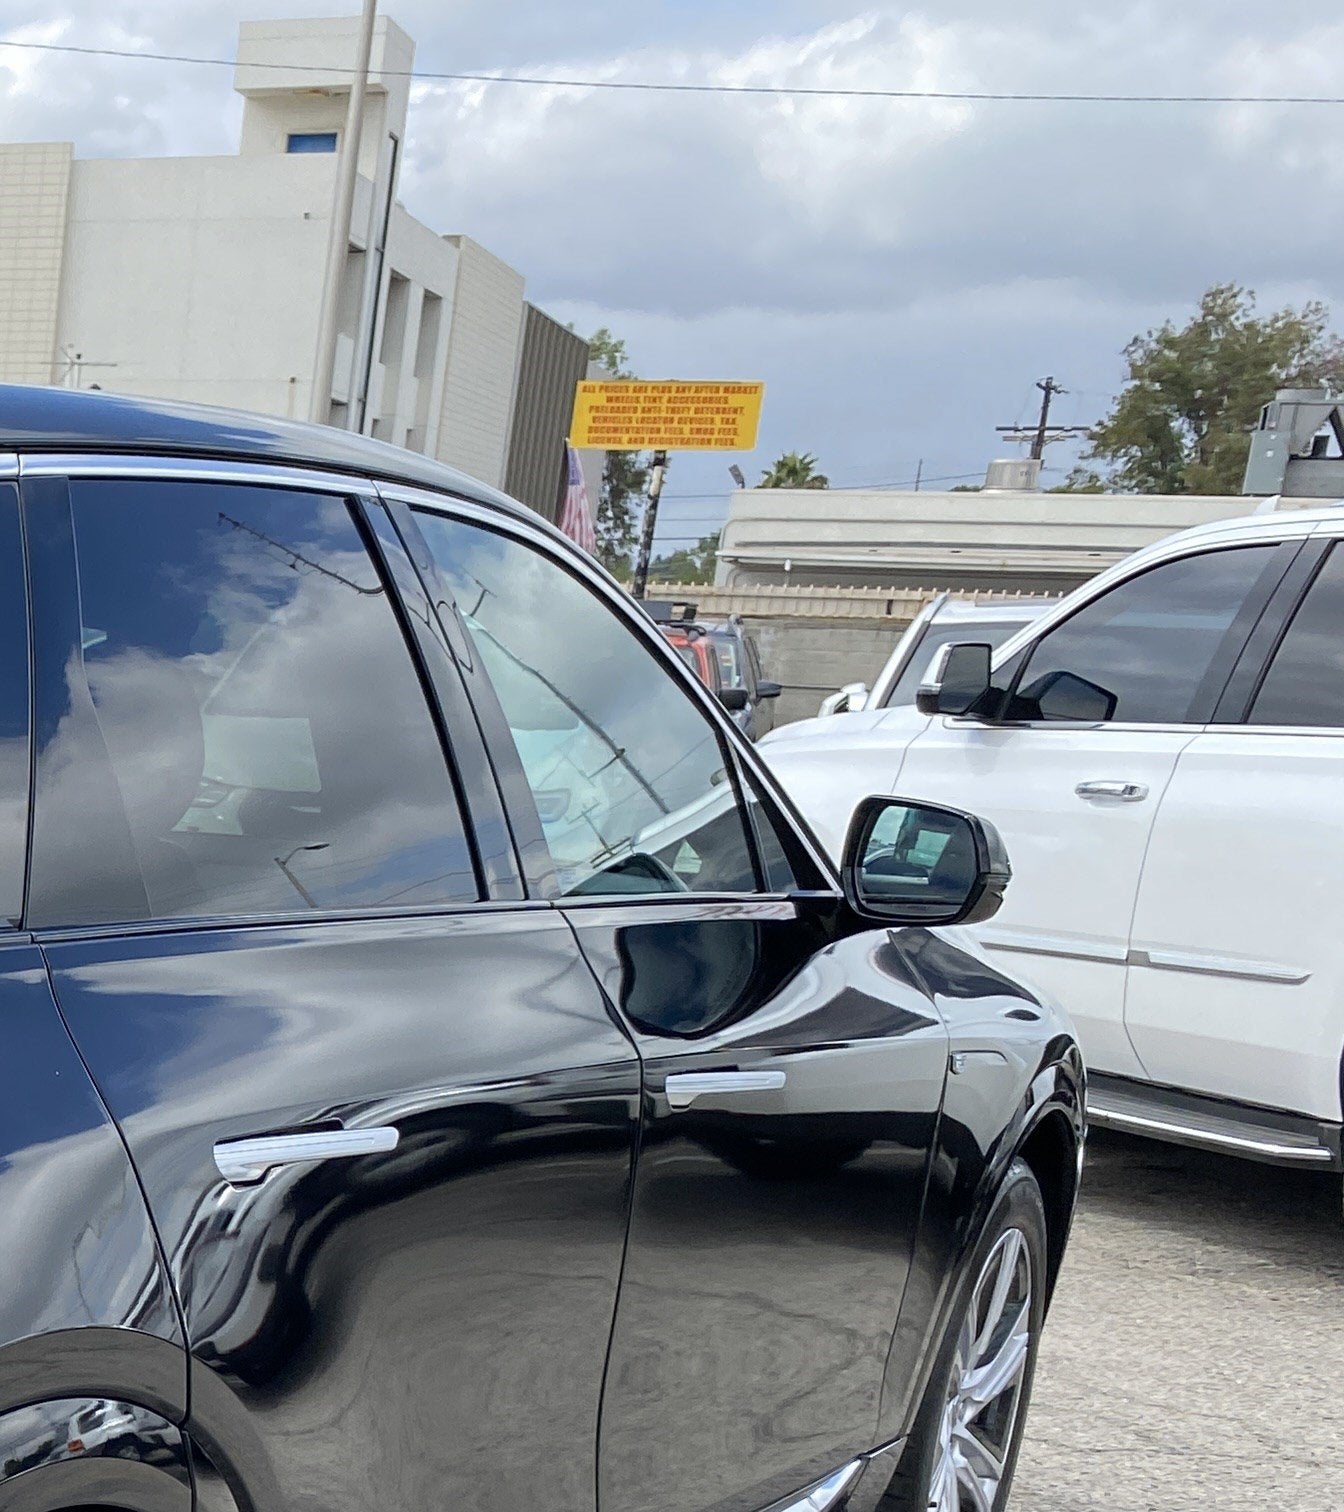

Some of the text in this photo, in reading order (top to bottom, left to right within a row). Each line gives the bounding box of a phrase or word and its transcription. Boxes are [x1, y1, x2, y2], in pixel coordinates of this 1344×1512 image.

[582, 384, 759, 395] ALL PRICES ARE PLUS ANY AFTER MARKET
[627, 437, 645, 446] AND
